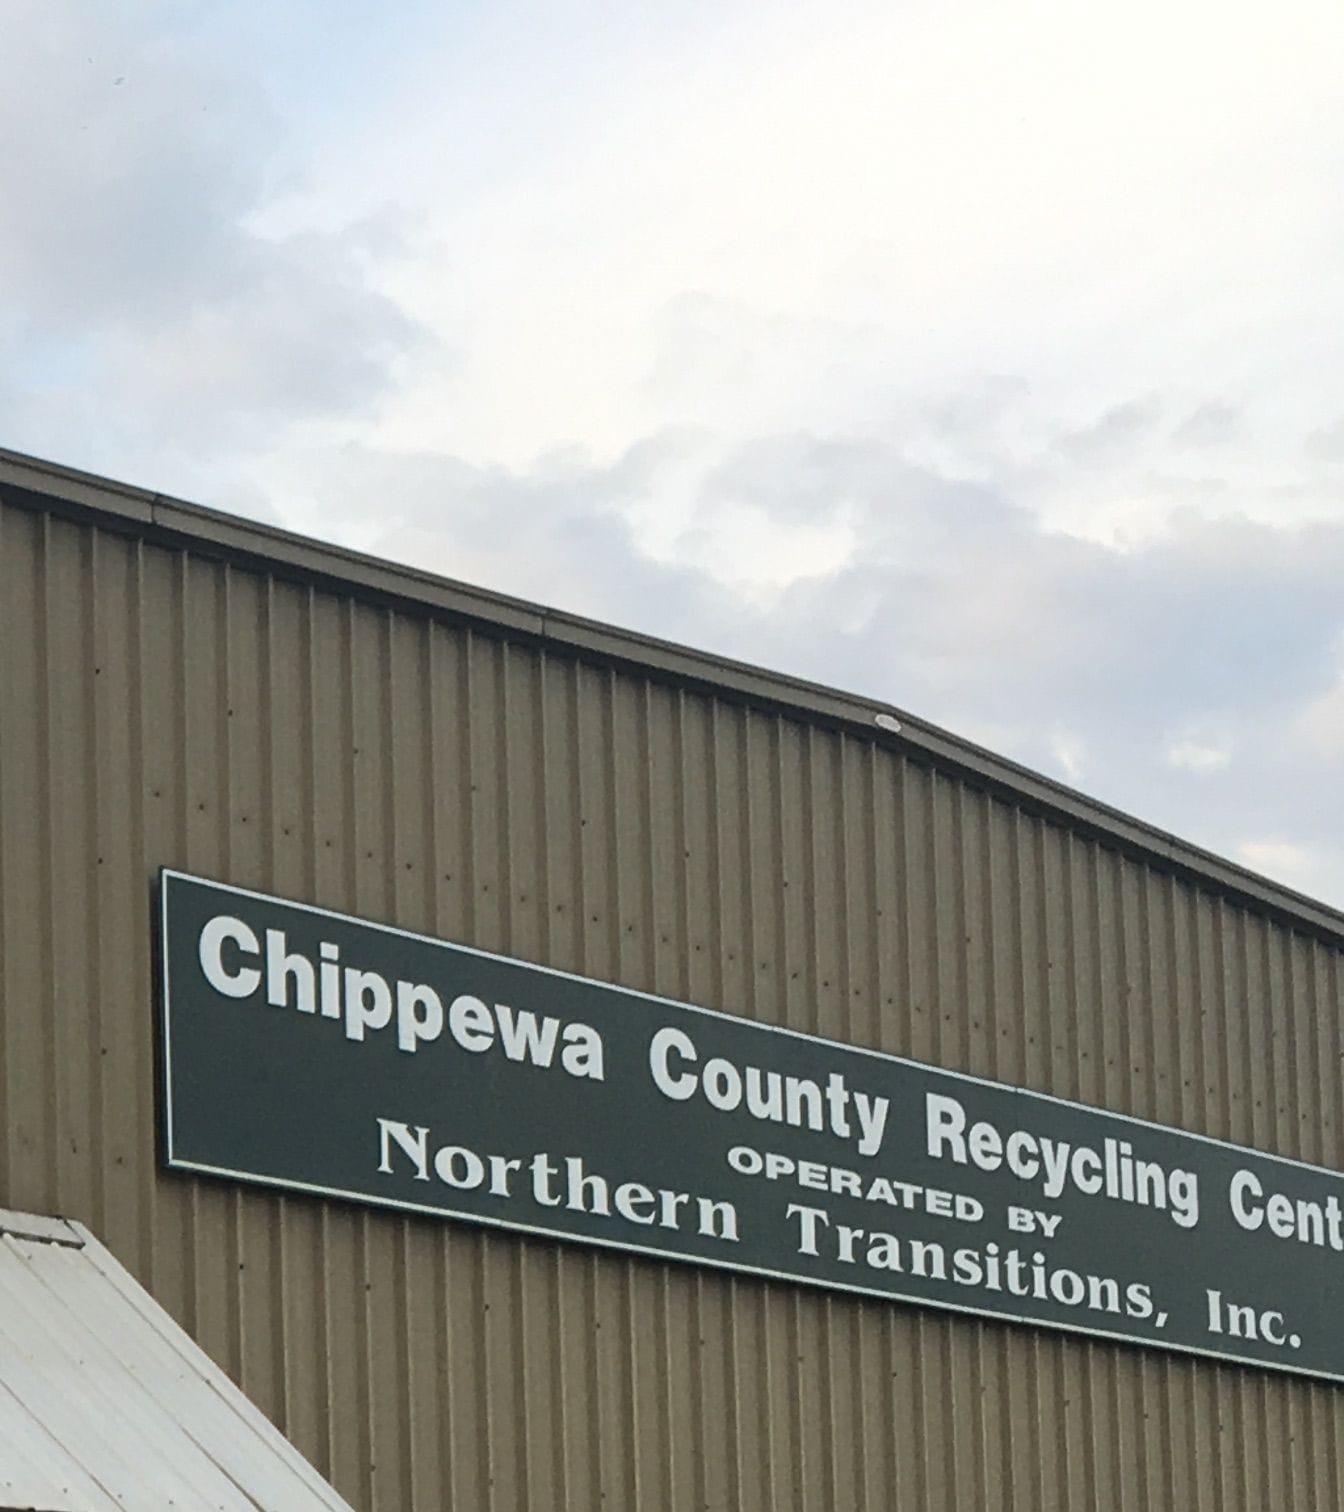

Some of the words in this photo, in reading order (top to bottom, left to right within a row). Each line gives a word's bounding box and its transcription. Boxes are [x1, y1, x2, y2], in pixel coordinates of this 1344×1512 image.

[199, 915, 604, 1081] Chippewa
[649, 1027, 890, 1156] County
[926, 1092, 1199, 1228] Recycling
[376, 1118, 742, 1242] Northern
[785, 1203, 1168, 1328] Transitions,
[1206, 1289, 1301, 1348] Inc.
[727, 1146, 984, 1222] OPERATED
[1007, 1206, 1063, 1238] BY
